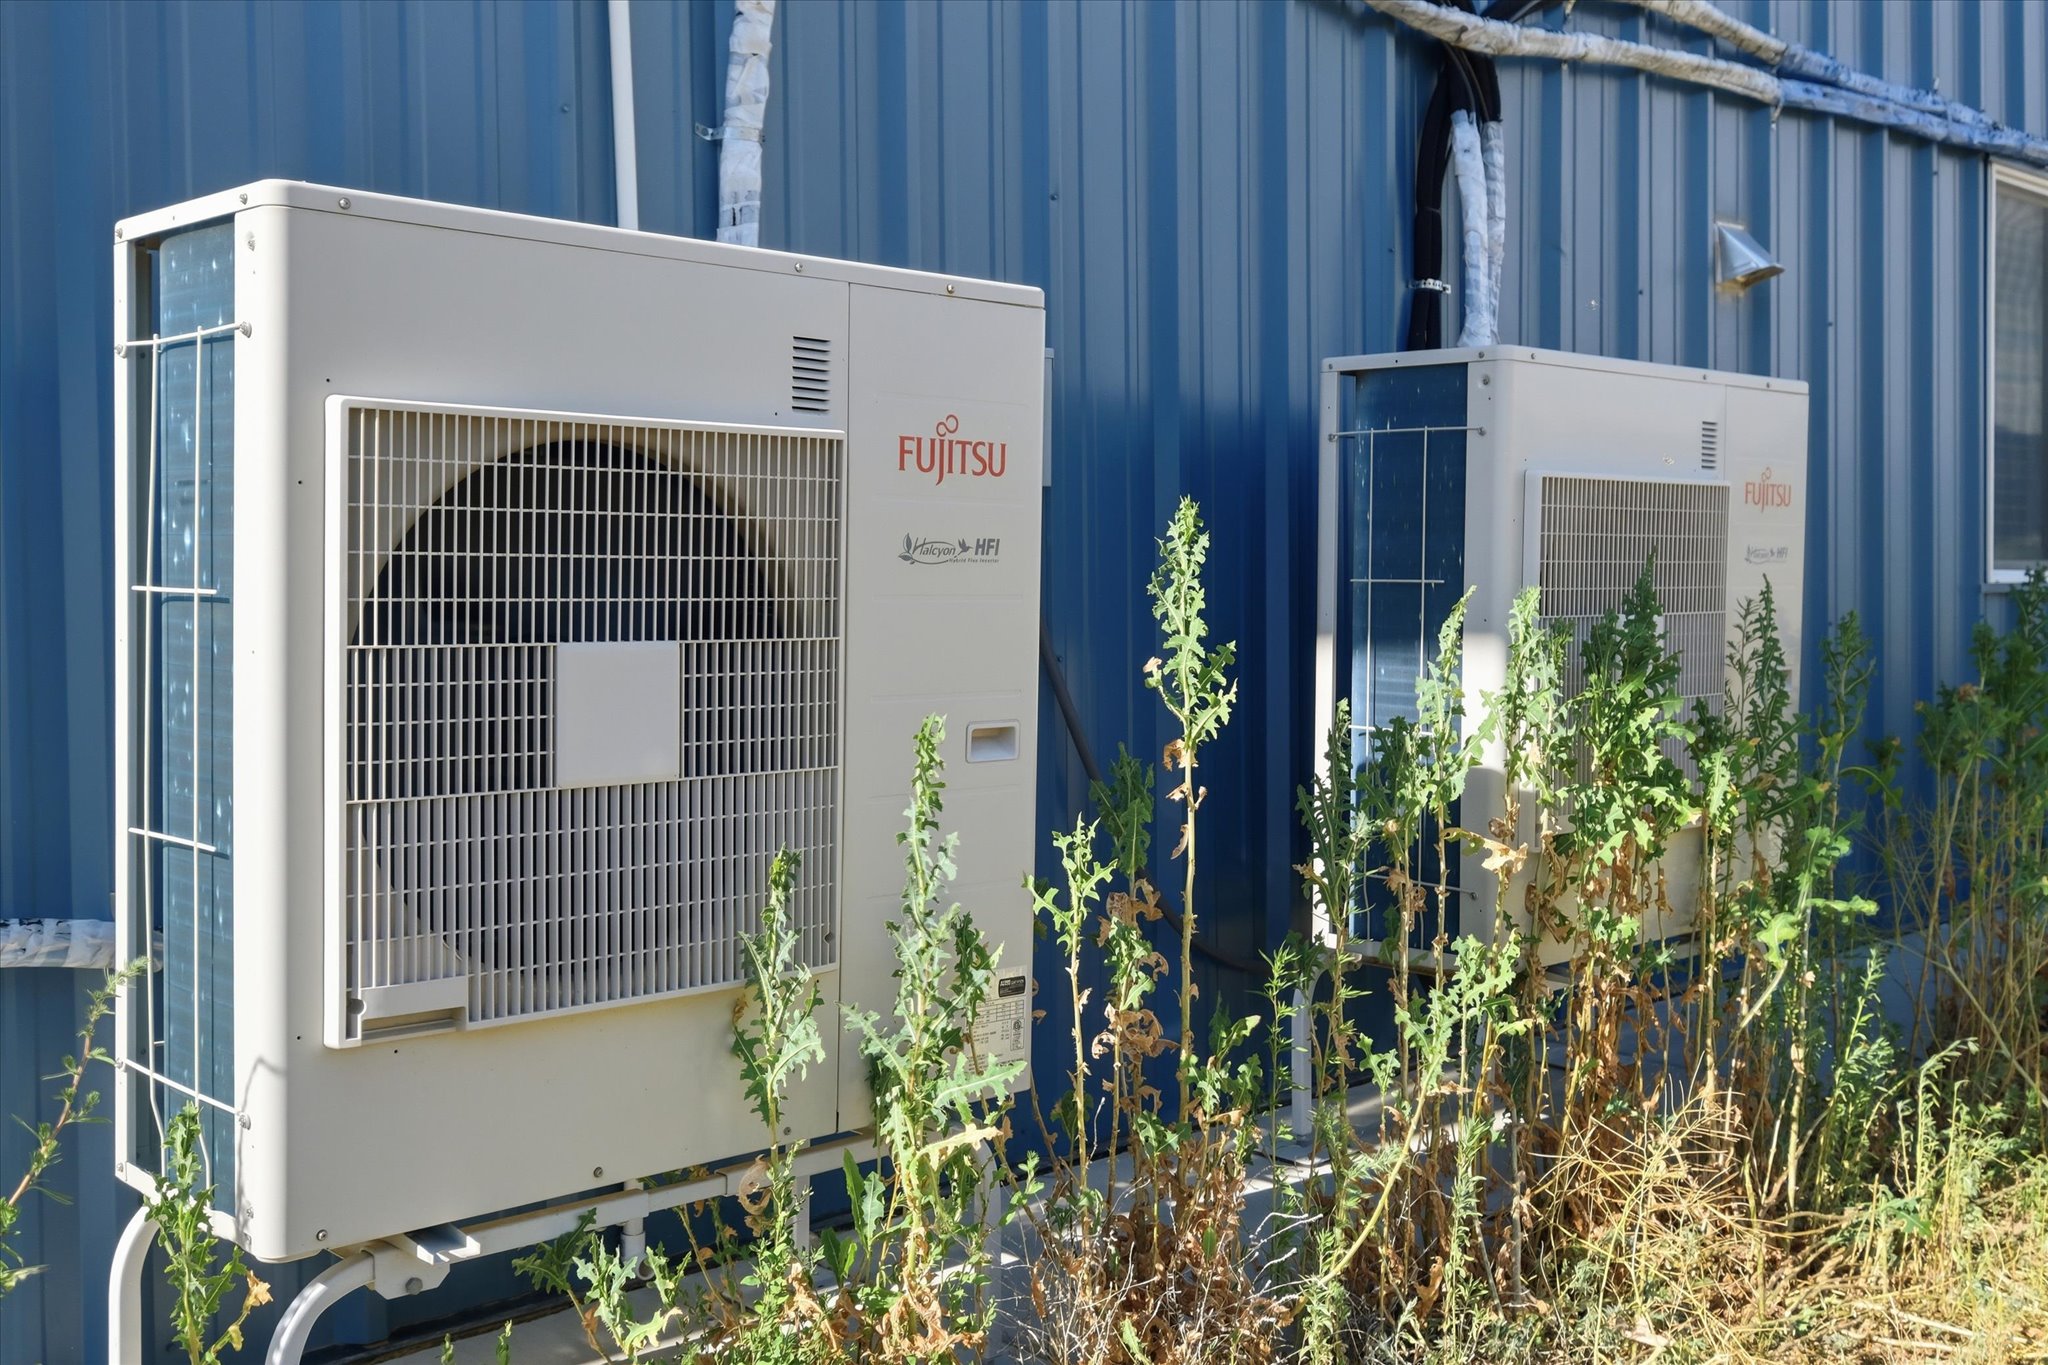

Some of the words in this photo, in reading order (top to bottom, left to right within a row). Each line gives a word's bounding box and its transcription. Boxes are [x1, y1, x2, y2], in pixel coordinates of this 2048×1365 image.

[898, 435, 1007, 486] FUJITSU
[1744, 481, 1792, 513] FUJITSU
[912, 537, 956, 557] Halcyon
[974, 538, 1000, 556] HFI
